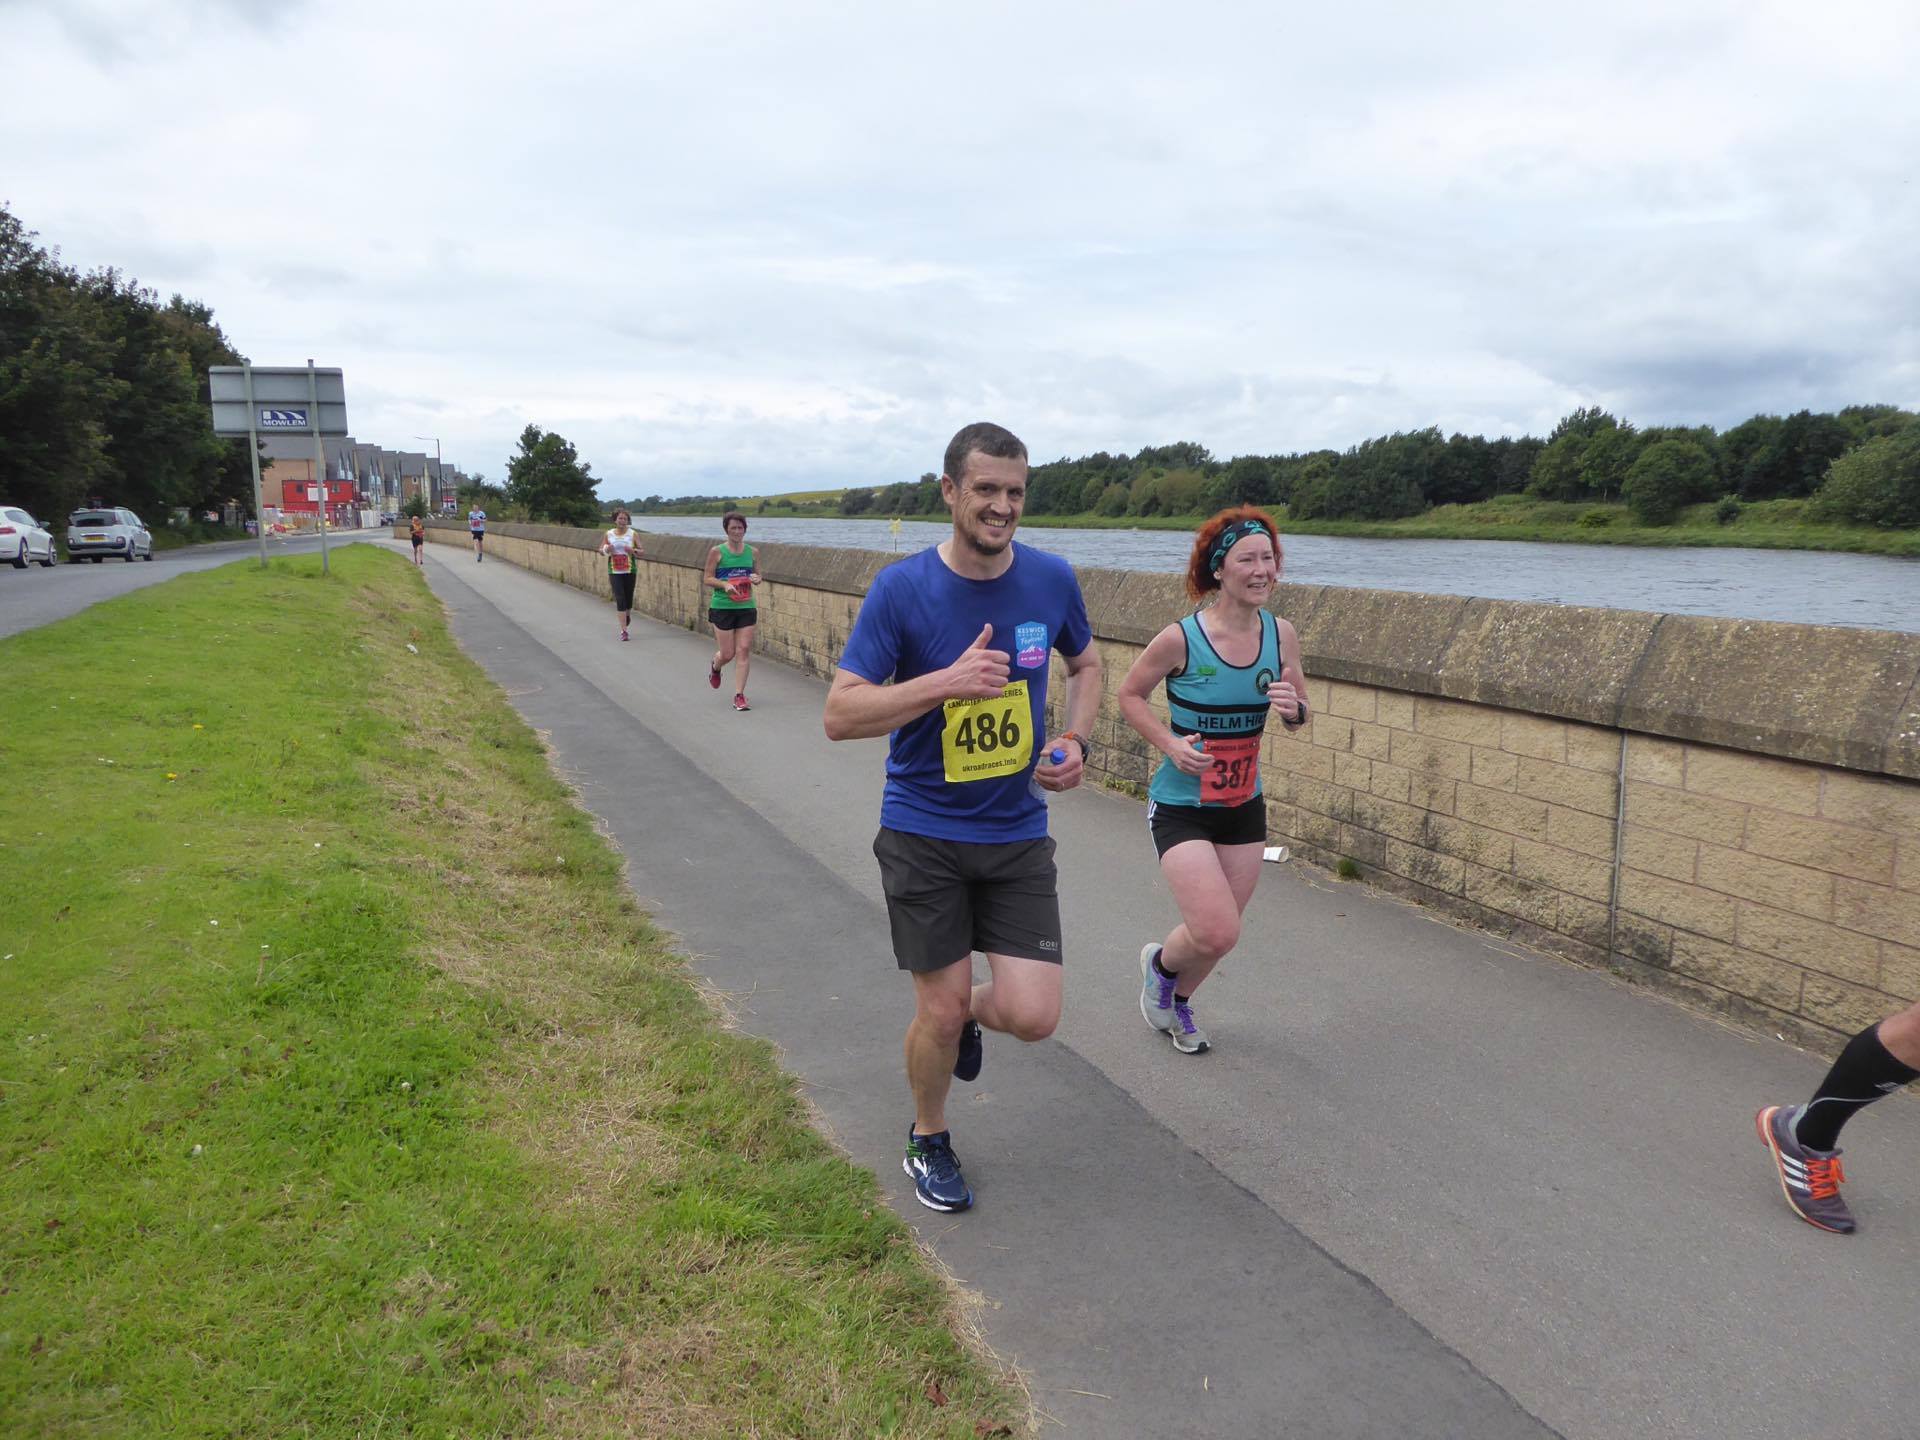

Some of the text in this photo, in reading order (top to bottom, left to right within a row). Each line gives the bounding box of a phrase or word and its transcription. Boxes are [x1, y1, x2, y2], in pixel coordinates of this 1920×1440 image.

[1002, 688, 1023, 698] ERIES
[1198, 716, 1241, 729] HELM
[955, 709, 1020, 755] 486
[963, 758, 1017, 771] ukroadraces.info
[1211, 756, 1252, 790] 387
